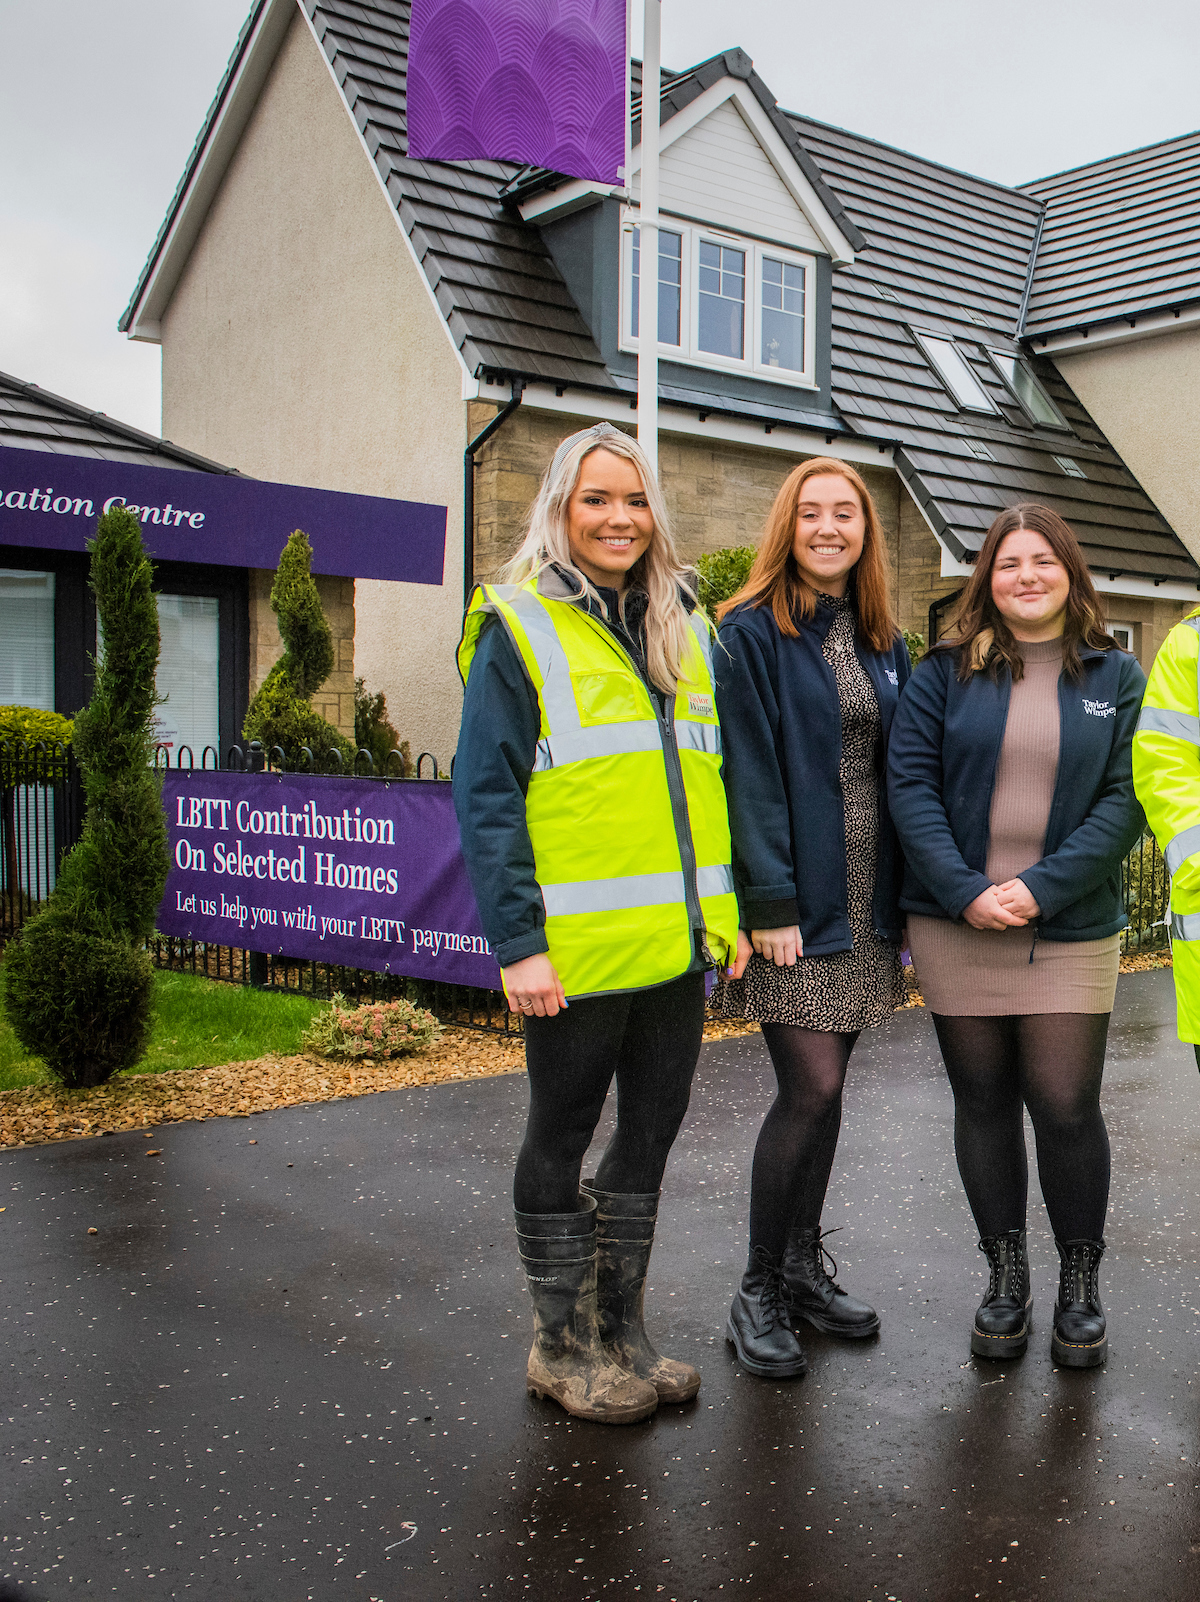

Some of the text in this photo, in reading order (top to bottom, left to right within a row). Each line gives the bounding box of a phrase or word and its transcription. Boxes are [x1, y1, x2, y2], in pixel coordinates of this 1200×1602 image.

[0, 488, 95, 517] ation
[1082, 699, 1109, 711] Taylor
[176, 796, 396, 845] LBTT Contribution
[175, 839, 399, 895] On Selected Homes
[176, 890, 197, 914] Let
[200, 899, 217, 916] us
[220, 893, 248, 928] help
[251, 906, 278, 930] you
[281, 904, 317, 931] with
[319, 916, 357, 941] your
[360, 915, 406, 943] LBTT
